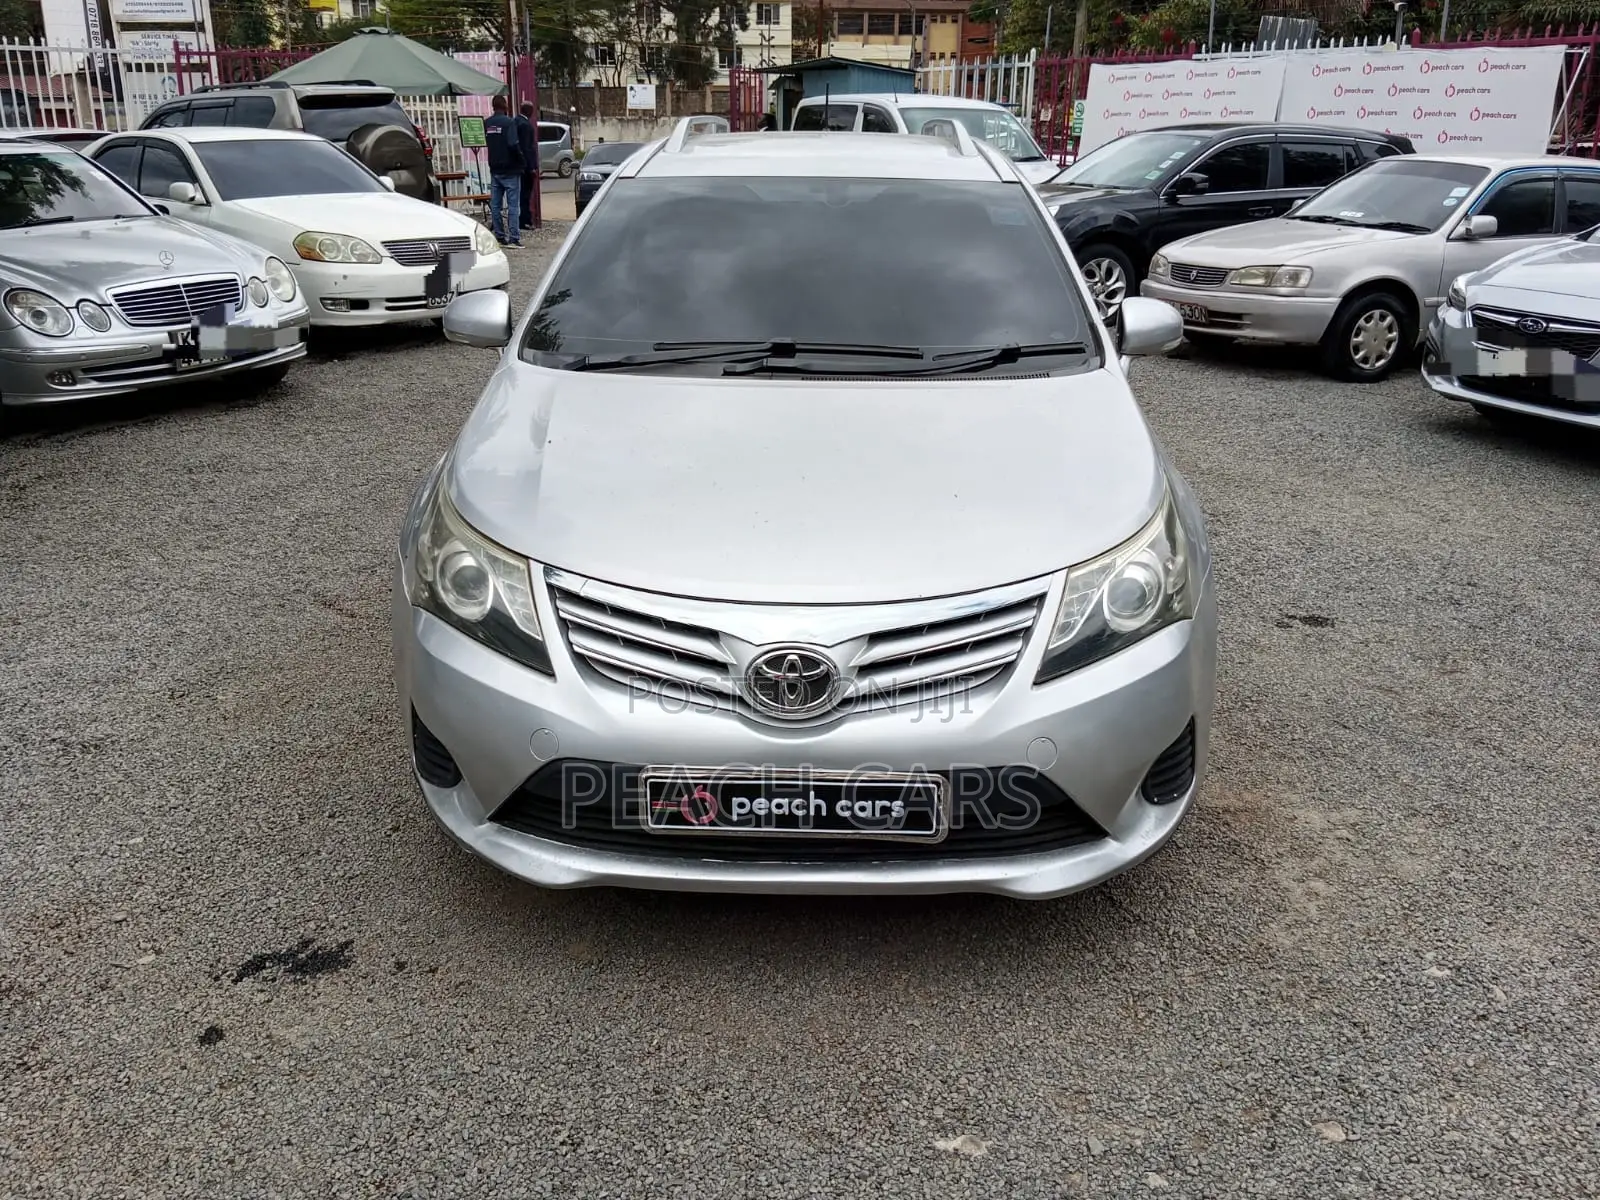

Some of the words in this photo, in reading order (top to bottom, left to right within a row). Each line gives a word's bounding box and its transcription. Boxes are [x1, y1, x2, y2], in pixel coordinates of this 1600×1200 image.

[1321, 66, 1339, 75] peach
[1339, 65, 1352, 73] cars
[1372, 64, 1391, 74] peach
[1391, 64, 1405, 72] cars
[1430, 63, 1450, 73] peach
[1450, 63, 1465, 71] cars
[1490, 62, 1511, 73] peach
[1511, 63, 1527, 71] cars
[1343, 87, 1361, 96] peach
[1398, 85, 1417, 95] peach
[1417, 86, 1431, 94] cars
[1456, 86, 1476, 96] peach
[1316, 109, 1333, 118] peach
[1366, 108, 1385, 118] peach
[1423, 109, 1443, 119] peach
[1481, 111, 1502, 120] peach
[1448, 132, 1468, 142] peach
[1468, 134, 1483, 142] cars
[732, 790, 827, 821] peach
[835, 798, 905, 818] cars
